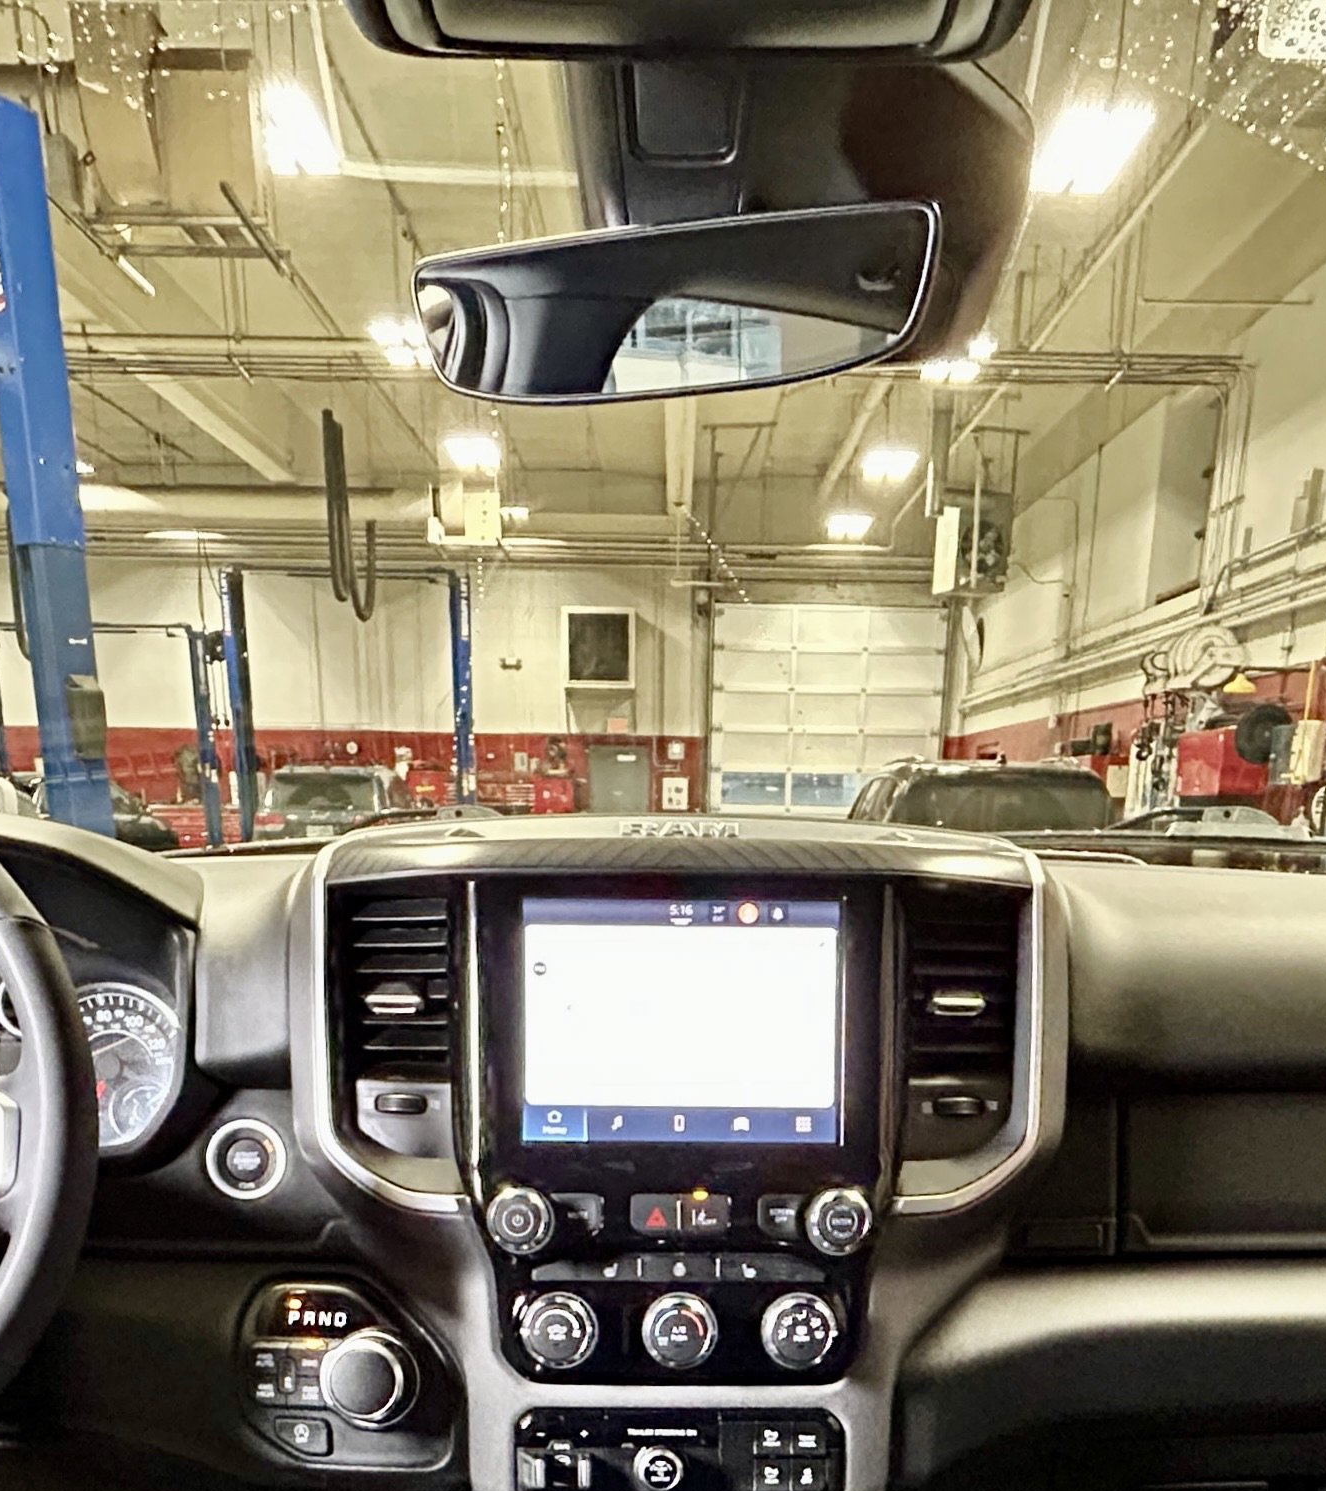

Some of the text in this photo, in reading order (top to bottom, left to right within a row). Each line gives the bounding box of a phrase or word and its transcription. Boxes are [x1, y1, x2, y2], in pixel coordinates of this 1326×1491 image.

[618, 821, 739, 838] RAM
[670, 903, 694, 916] 5:16
[96, 1010, 112, 1022] 80
[124, 1015, 144, 1028] 100
